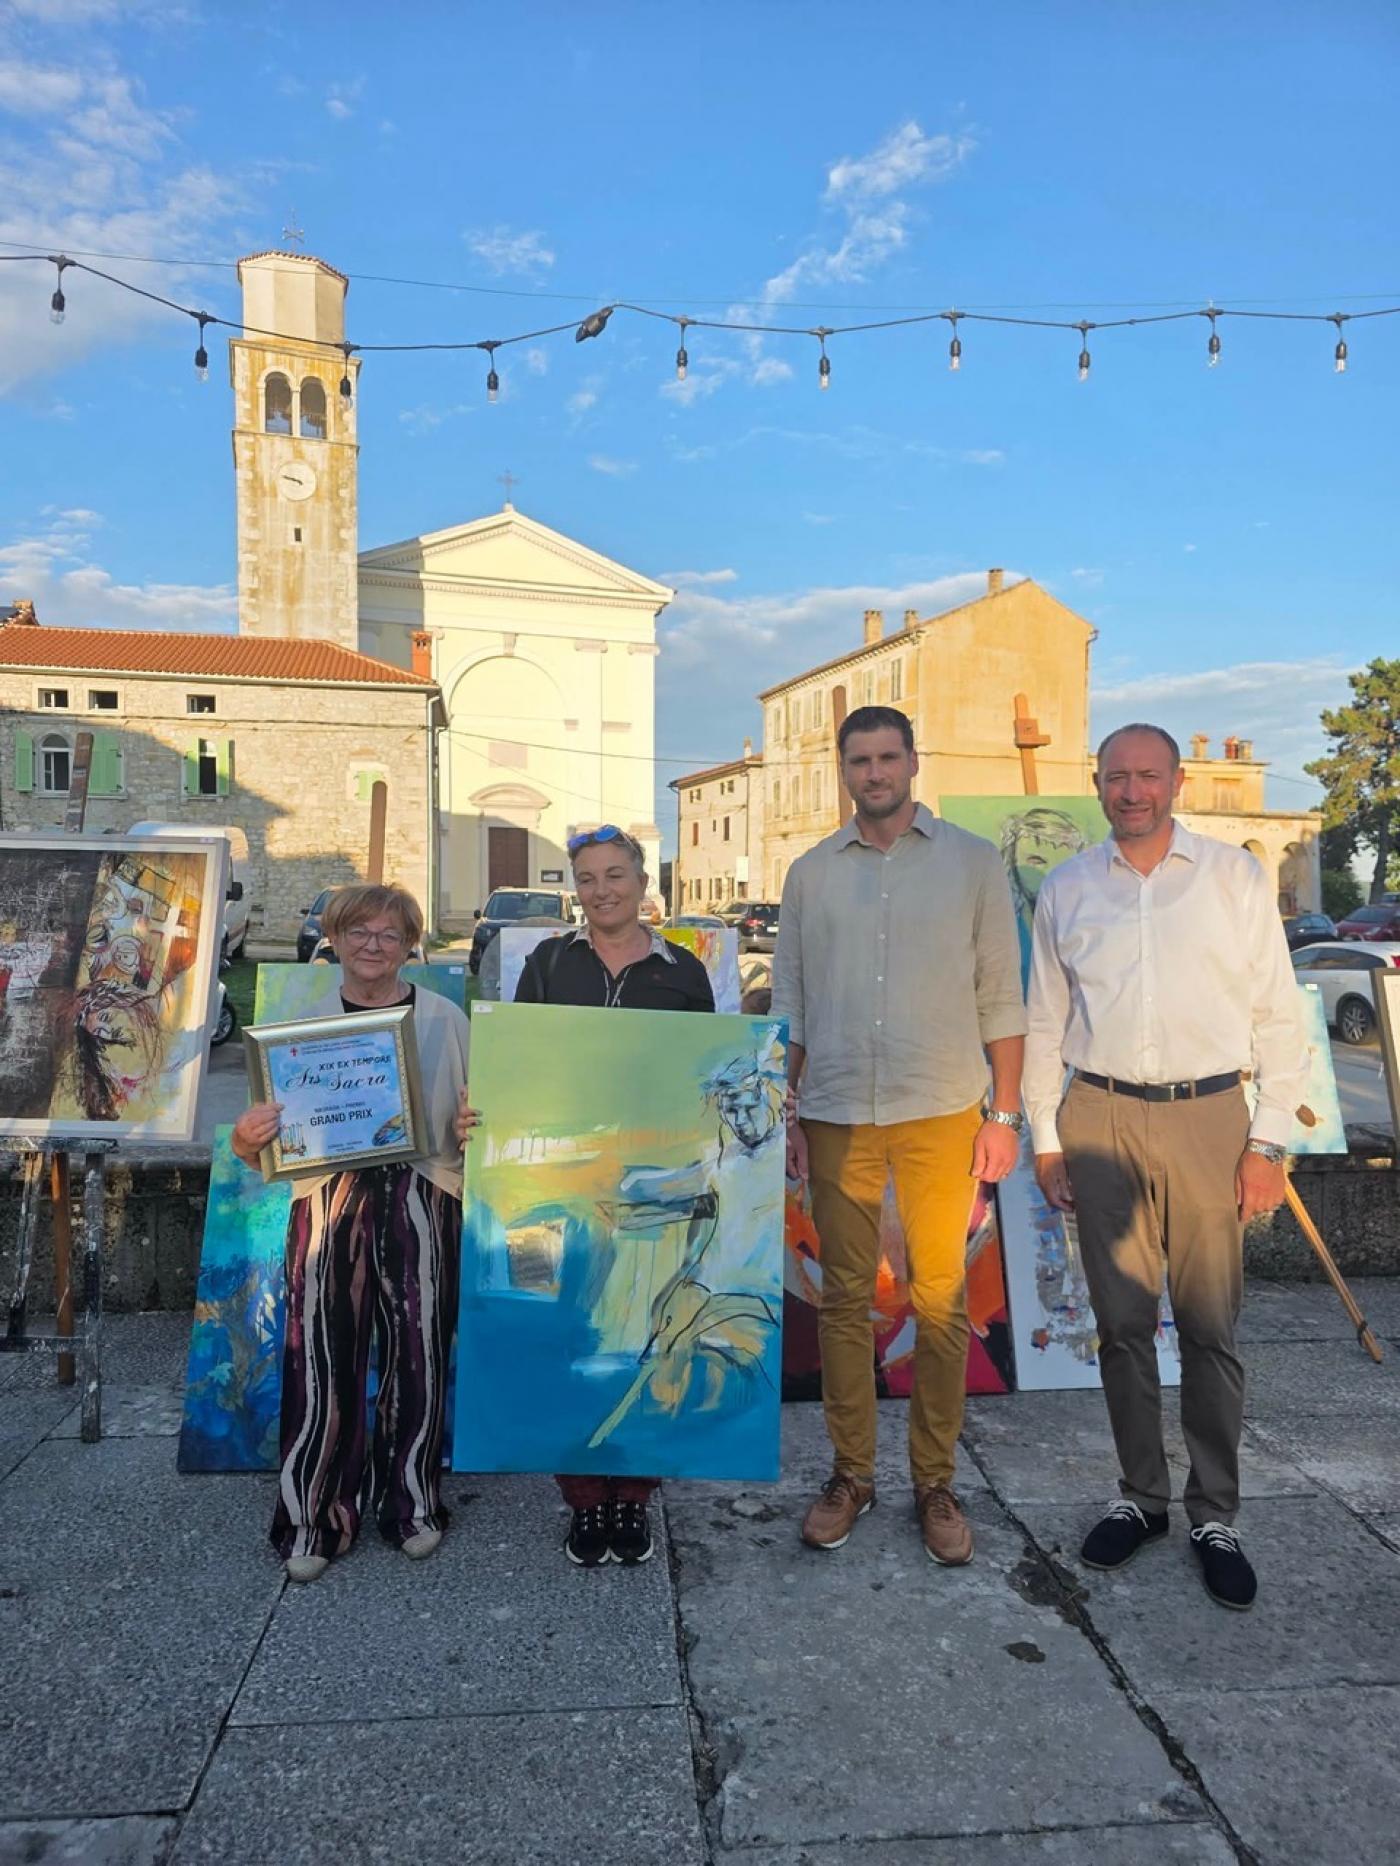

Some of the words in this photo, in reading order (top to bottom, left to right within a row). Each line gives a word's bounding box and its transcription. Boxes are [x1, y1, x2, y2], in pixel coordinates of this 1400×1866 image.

[319, 1061, 335, 1071] XIX
[338, 1060, 349, 1069] EX
[352, 1054, 391, 1067] TEMPORE
[282, 1066, 321, 1091] Ars
[327, 1072, 386, 1093] Sacra
[310, 1112, 346, 1126] GRAND
[349, 1108, 373, 1121] PRIX
